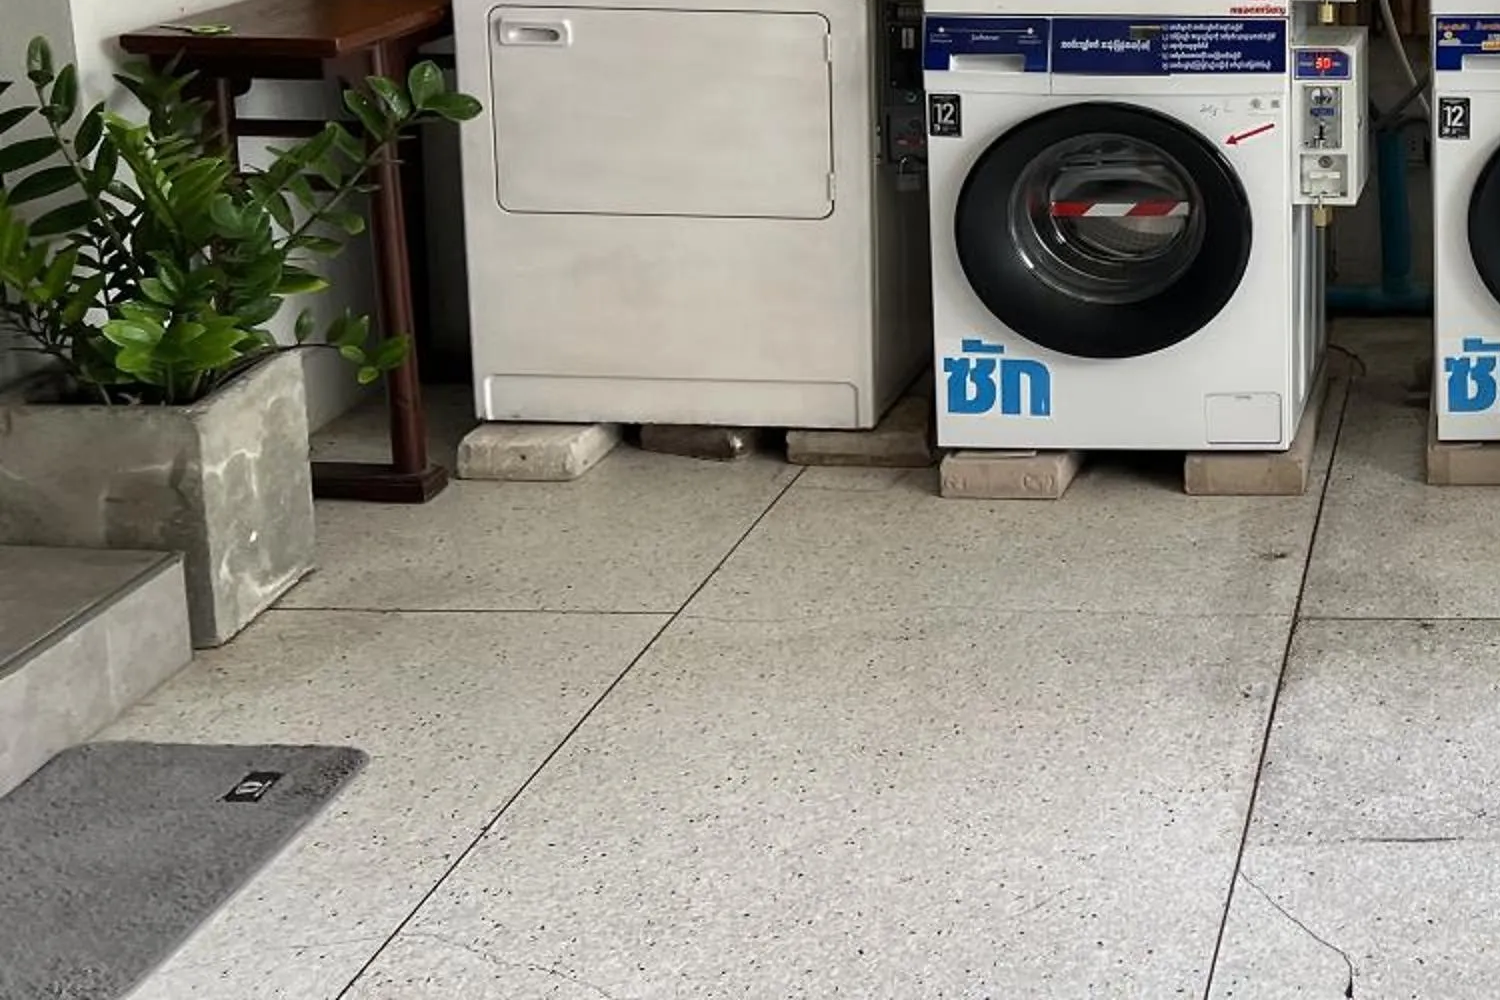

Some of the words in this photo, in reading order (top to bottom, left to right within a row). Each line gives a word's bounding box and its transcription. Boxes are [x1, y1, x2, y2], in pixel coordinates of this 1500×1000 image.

[933, 103, 955, 125] 12
[1443, 105, 1464, 127] 12
[943, 339, 1051, 416] ซัก
